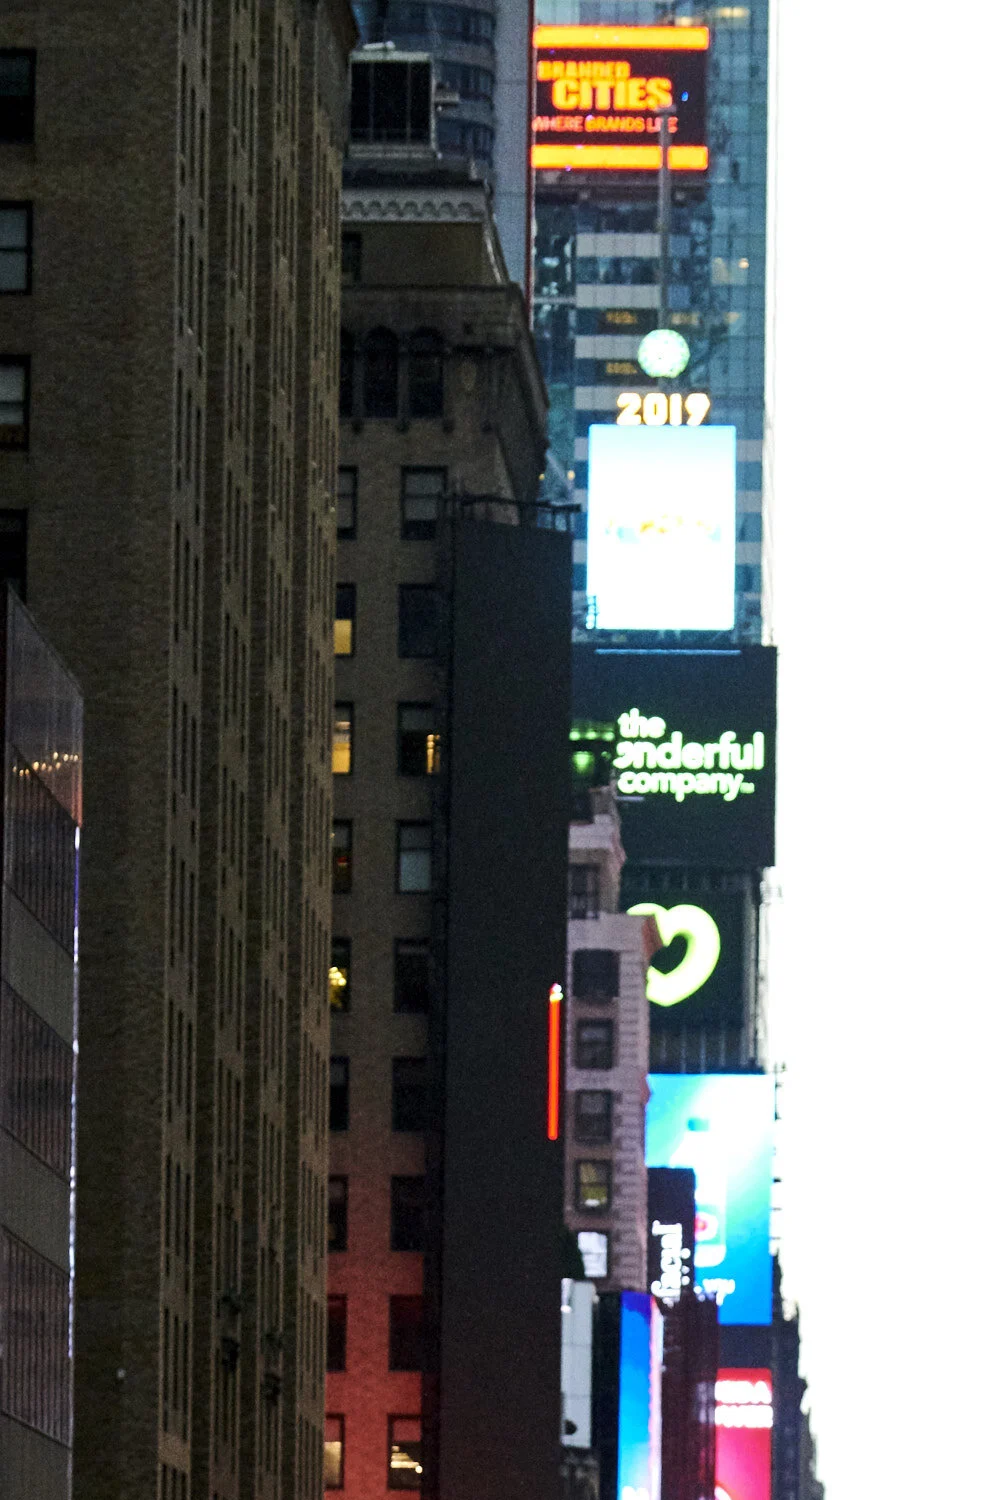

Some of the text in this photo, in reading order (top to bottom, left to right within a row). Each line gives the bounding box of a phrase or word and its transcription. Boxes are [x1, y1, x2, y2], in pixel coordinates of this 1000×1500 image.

[537, 61, 631, 80] BRANDED
[552, 77, 673, 110] CITIES
[532, 116, 678, 133] WHERE BRANDS LIE
[616, 392, 710, 426] 2019
[618, 707, 666, 738] the
[617, 771, 744, 802] company
